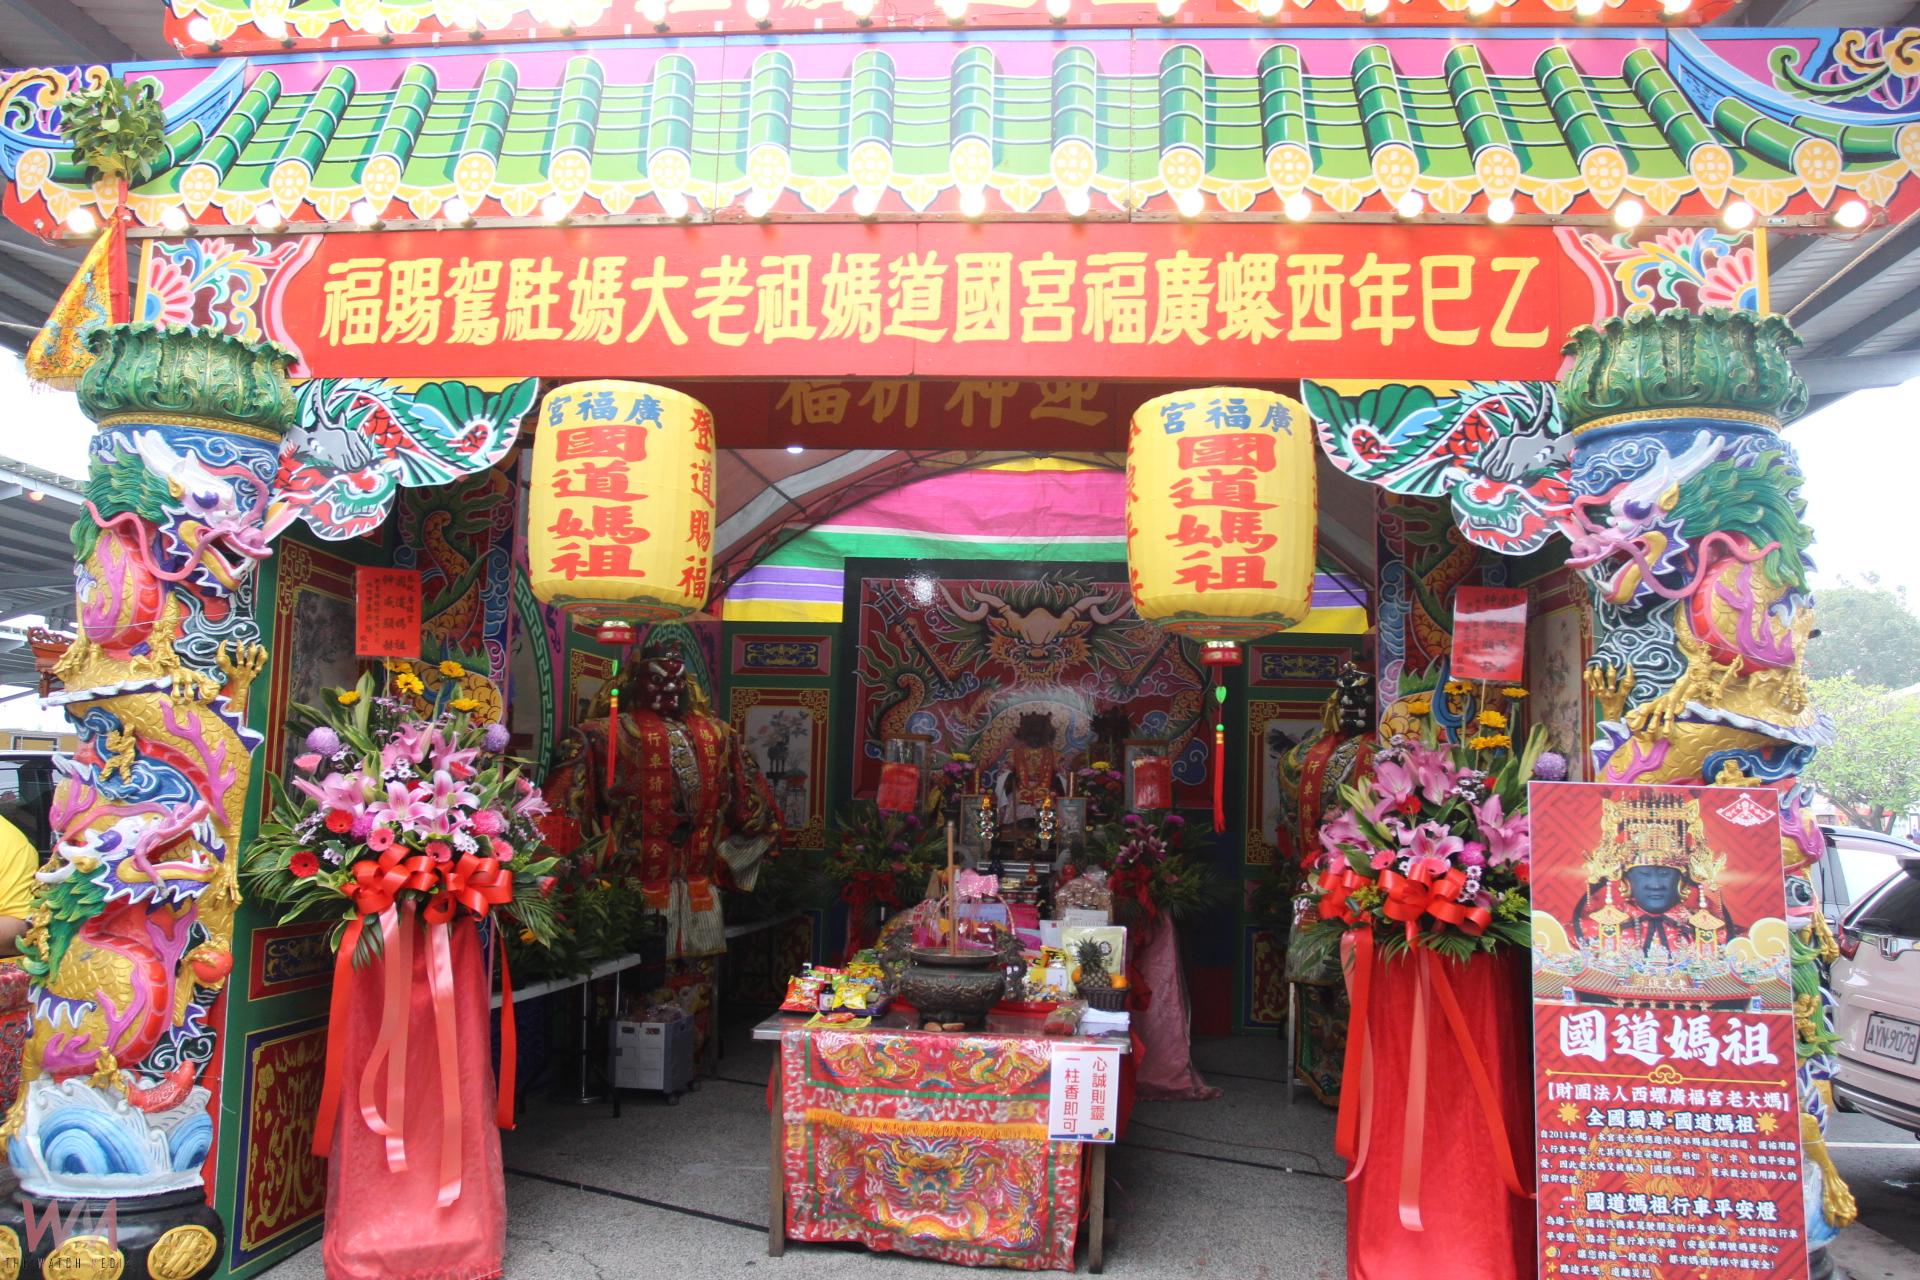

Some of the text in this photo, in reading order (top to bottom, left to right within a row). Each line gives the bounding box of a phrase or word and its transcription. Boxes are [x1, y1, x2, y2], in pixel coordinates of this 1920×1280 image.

[547, 391, 664, 429] 廣福宮
[1160, 399, 1293, 435] 廣福宮
[547, 425, 650, 581] 國道媽祖
[1166, 433, 1280, 592] 國道媽祖
[1560, 1009, 1779, 1067] 國道媽祖
[1867, 1024, 1917, 1055] AYN-9078
[1091, 1056, 1108, 1120] 心誠則靈
[1585, 1191, 1778, 1221] 國道媽祖行車平安燈
